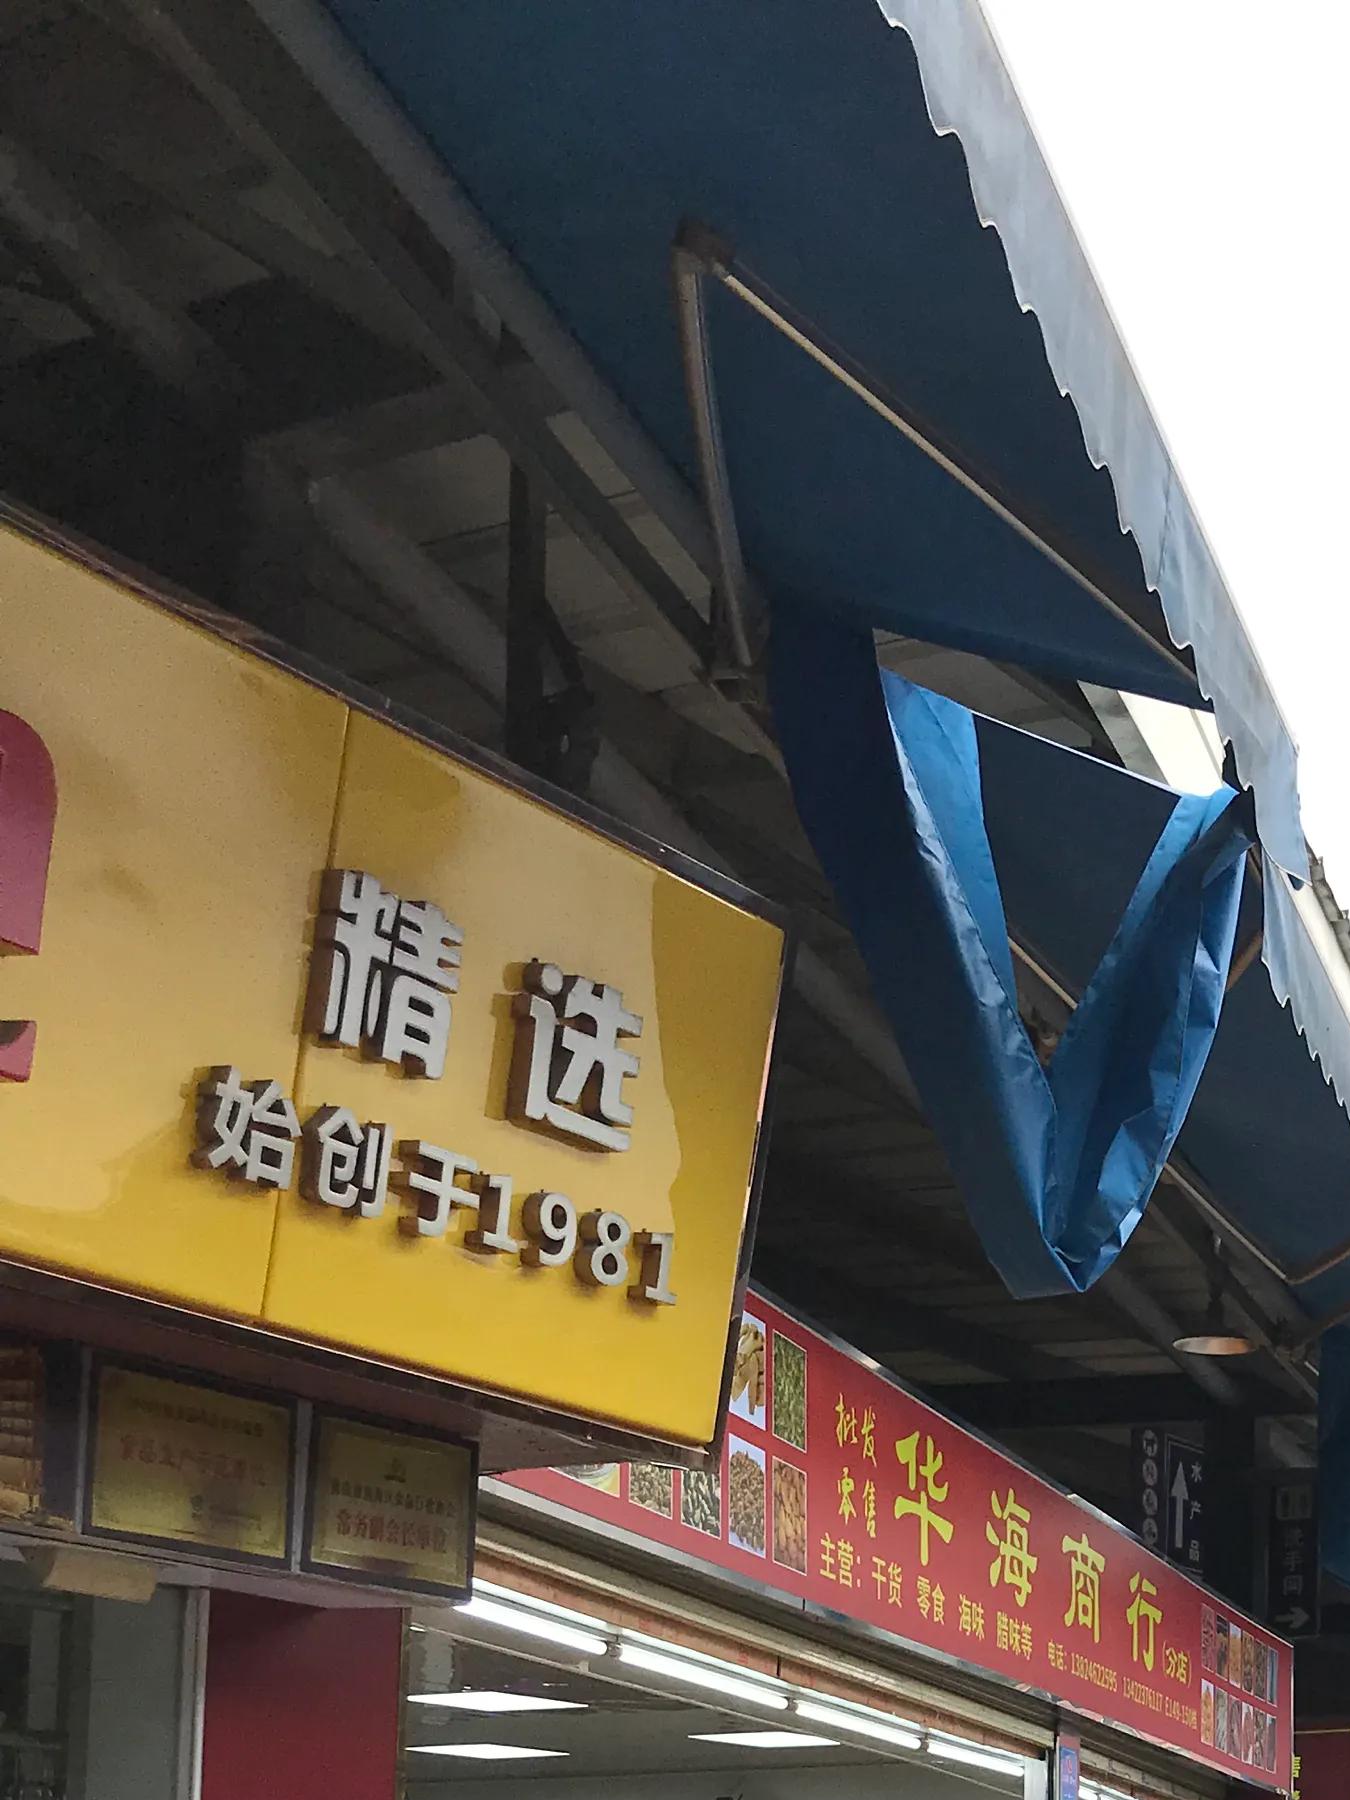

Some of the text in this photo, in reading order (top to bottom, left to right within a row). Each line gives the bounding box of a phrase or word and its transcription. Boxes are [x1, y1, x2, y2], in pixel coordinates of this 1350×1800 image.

[315, 868, 643, 1153] 精选
[200, 1065, 677, 1305] 始创于1981
[835, 1392, 878, 1468] 批发
[837, 1466, 877, 1538] 零售
[871, 1556, 903, 1609] 干货
[916, 1575, 946, 1626] 零食
[958, 1594, 985, 1640] 海味
[996, 1611, 1033, 1661] 腊味等
[894, 1430, 1163, 1672] 华海商行
